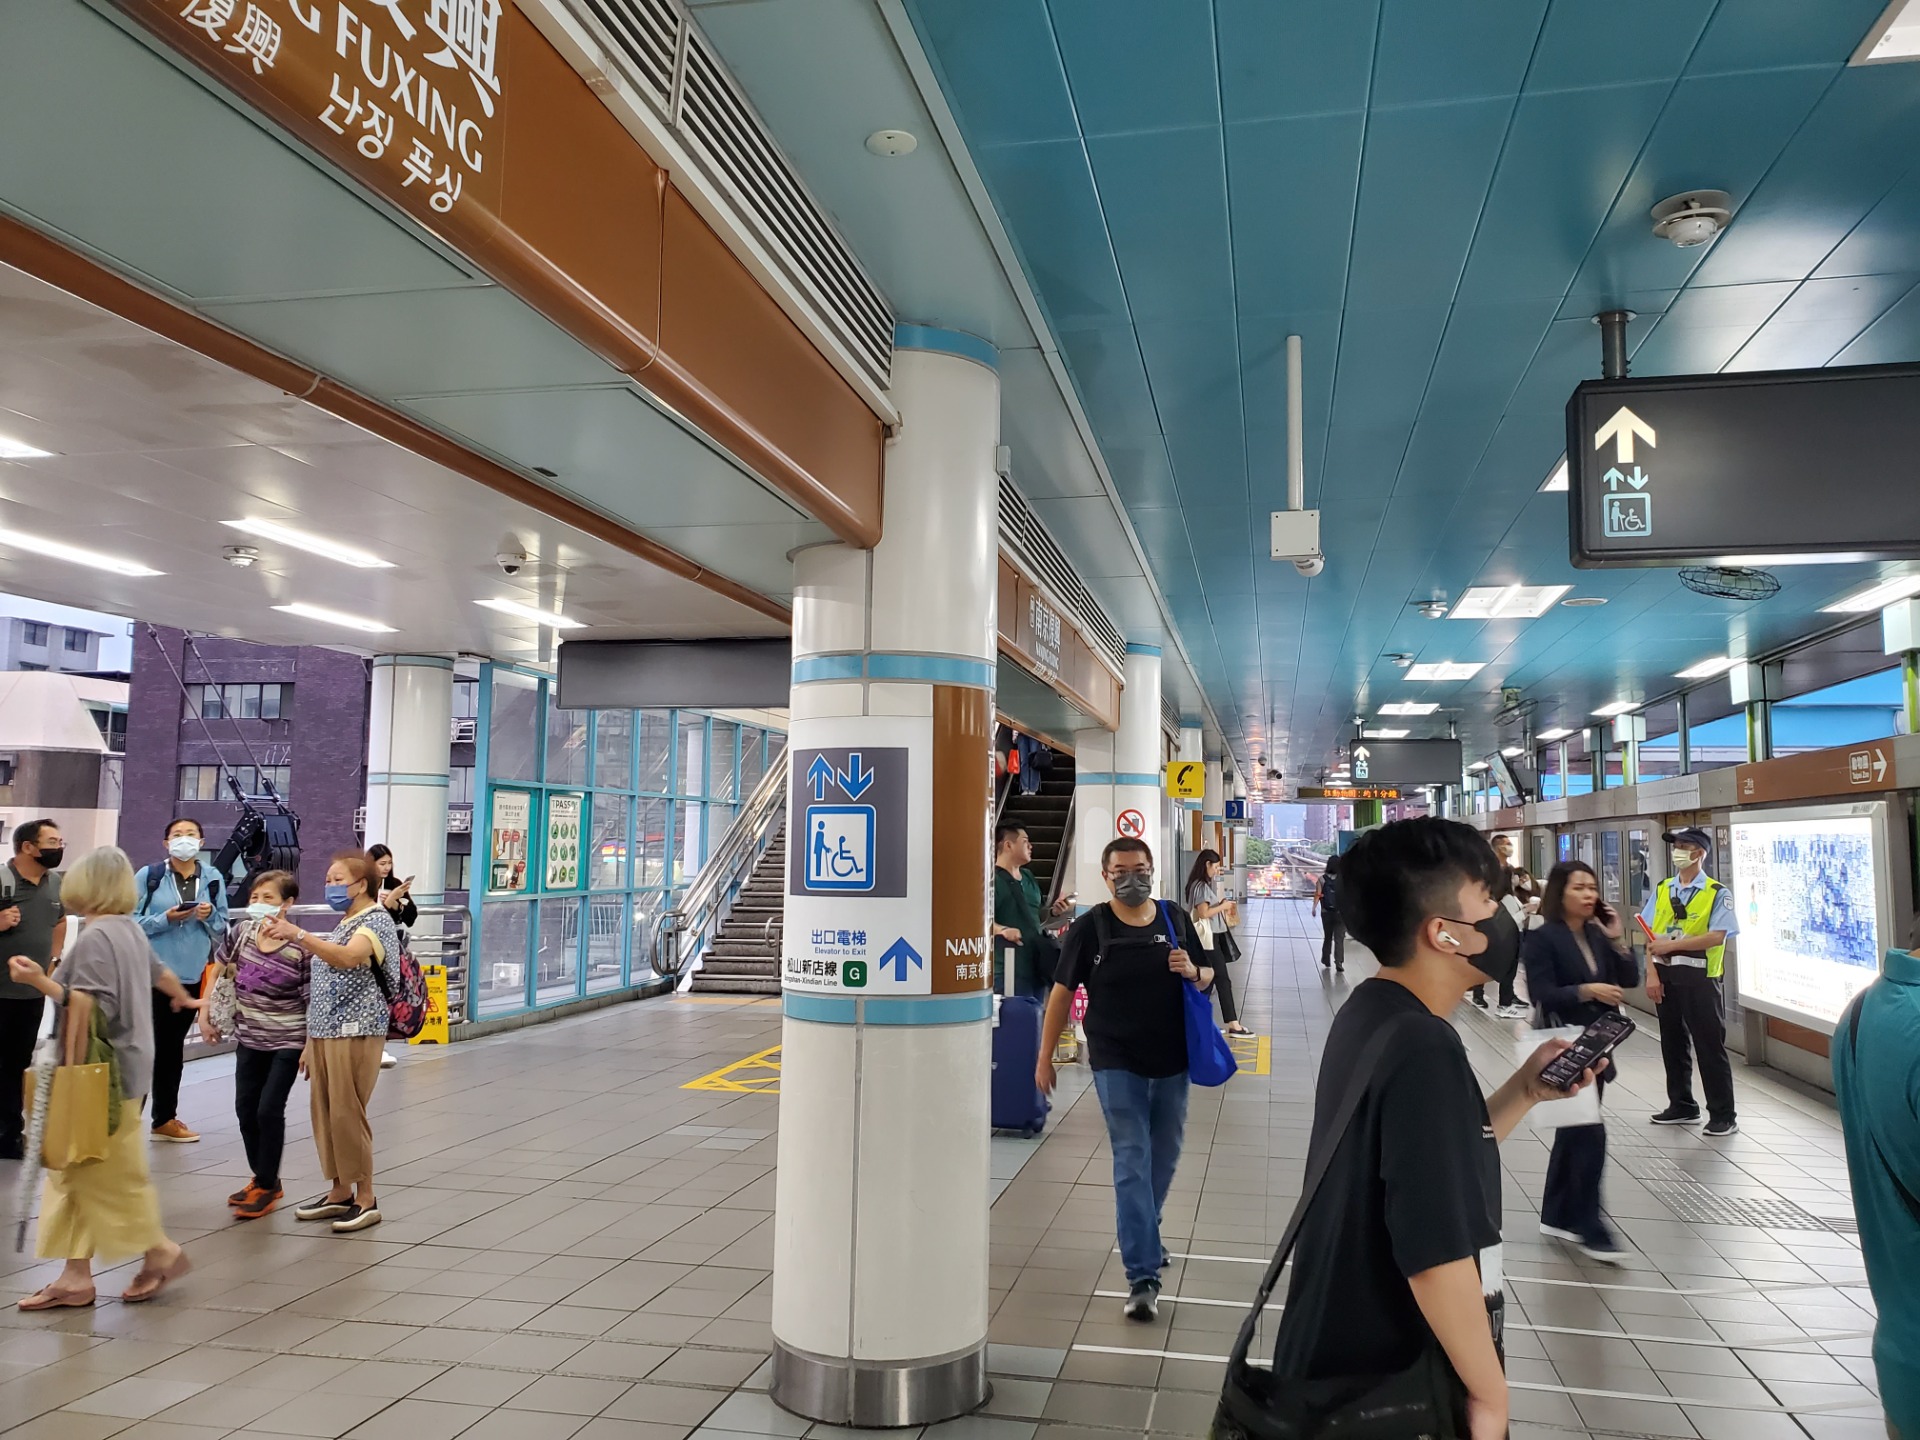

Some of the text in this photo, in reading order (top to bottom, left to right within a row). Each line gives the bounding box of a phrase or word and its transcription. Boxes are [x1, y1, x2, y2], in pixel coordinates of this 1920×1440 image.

[336, 1, 484, 173] FUXING
[317, 72, 463, 213] 난징 푸싱
[811, 928, 867, 946] 出口電梯
[814, 947, 867, 956] Elevator to Exit
[849, 967, 860, 980] G
[823, 979, 838, 987] Line
